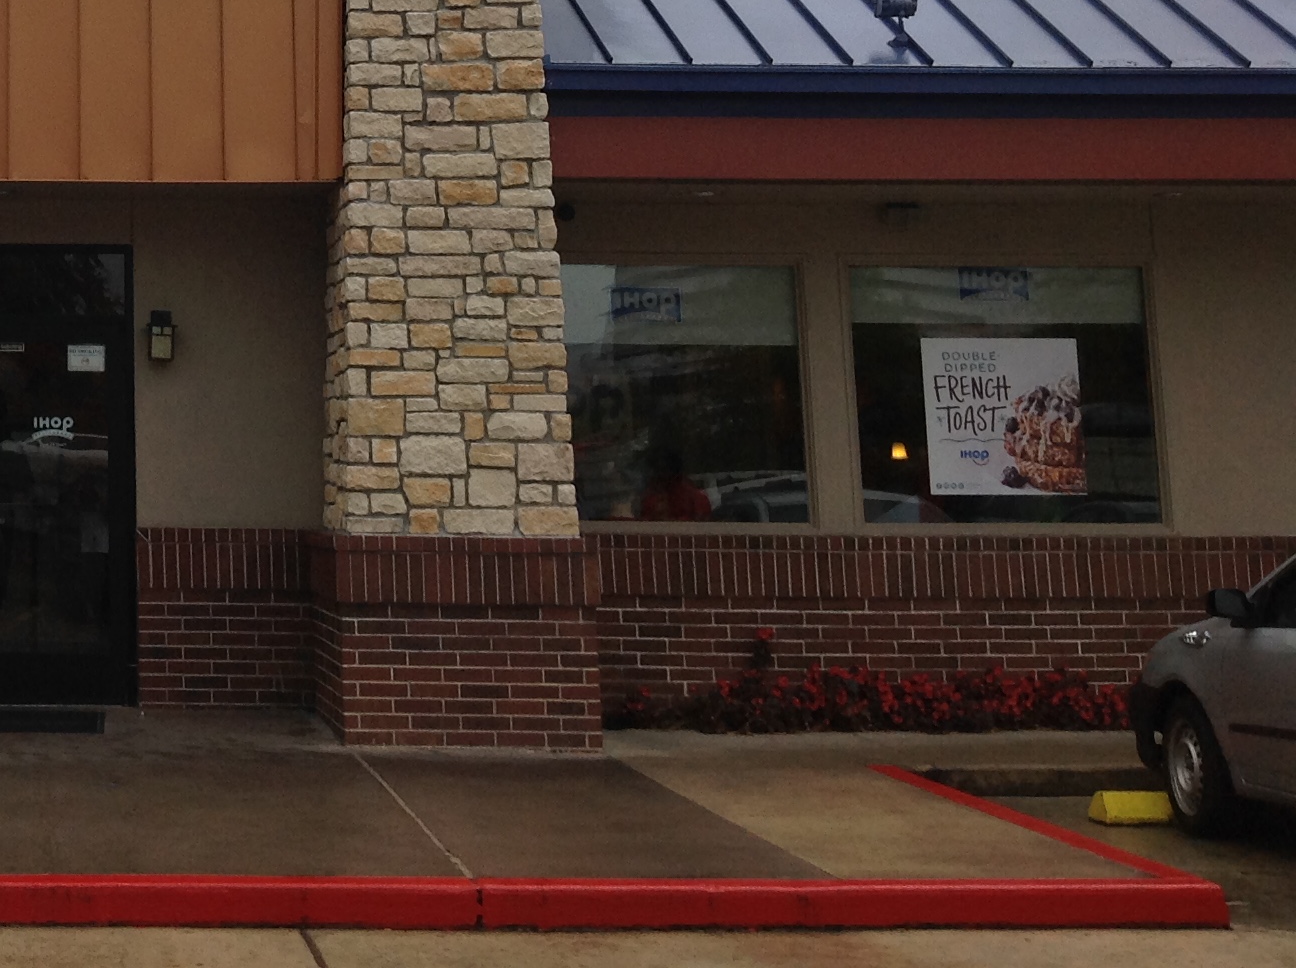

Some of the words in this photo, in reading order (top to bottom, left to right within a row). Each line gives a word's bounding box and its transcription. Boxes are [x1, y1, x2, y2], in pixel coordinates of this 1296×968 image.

[611, 291, 677, 316] IHOP
[944, 363, 997, 373] DIPPED
[933, 374, 1011, 403] FRENCH
[33, 416, 74, 433] IHOP
[935, 404, 1007, 436] TOAST
[960, 449, 989, 461] IHOP
